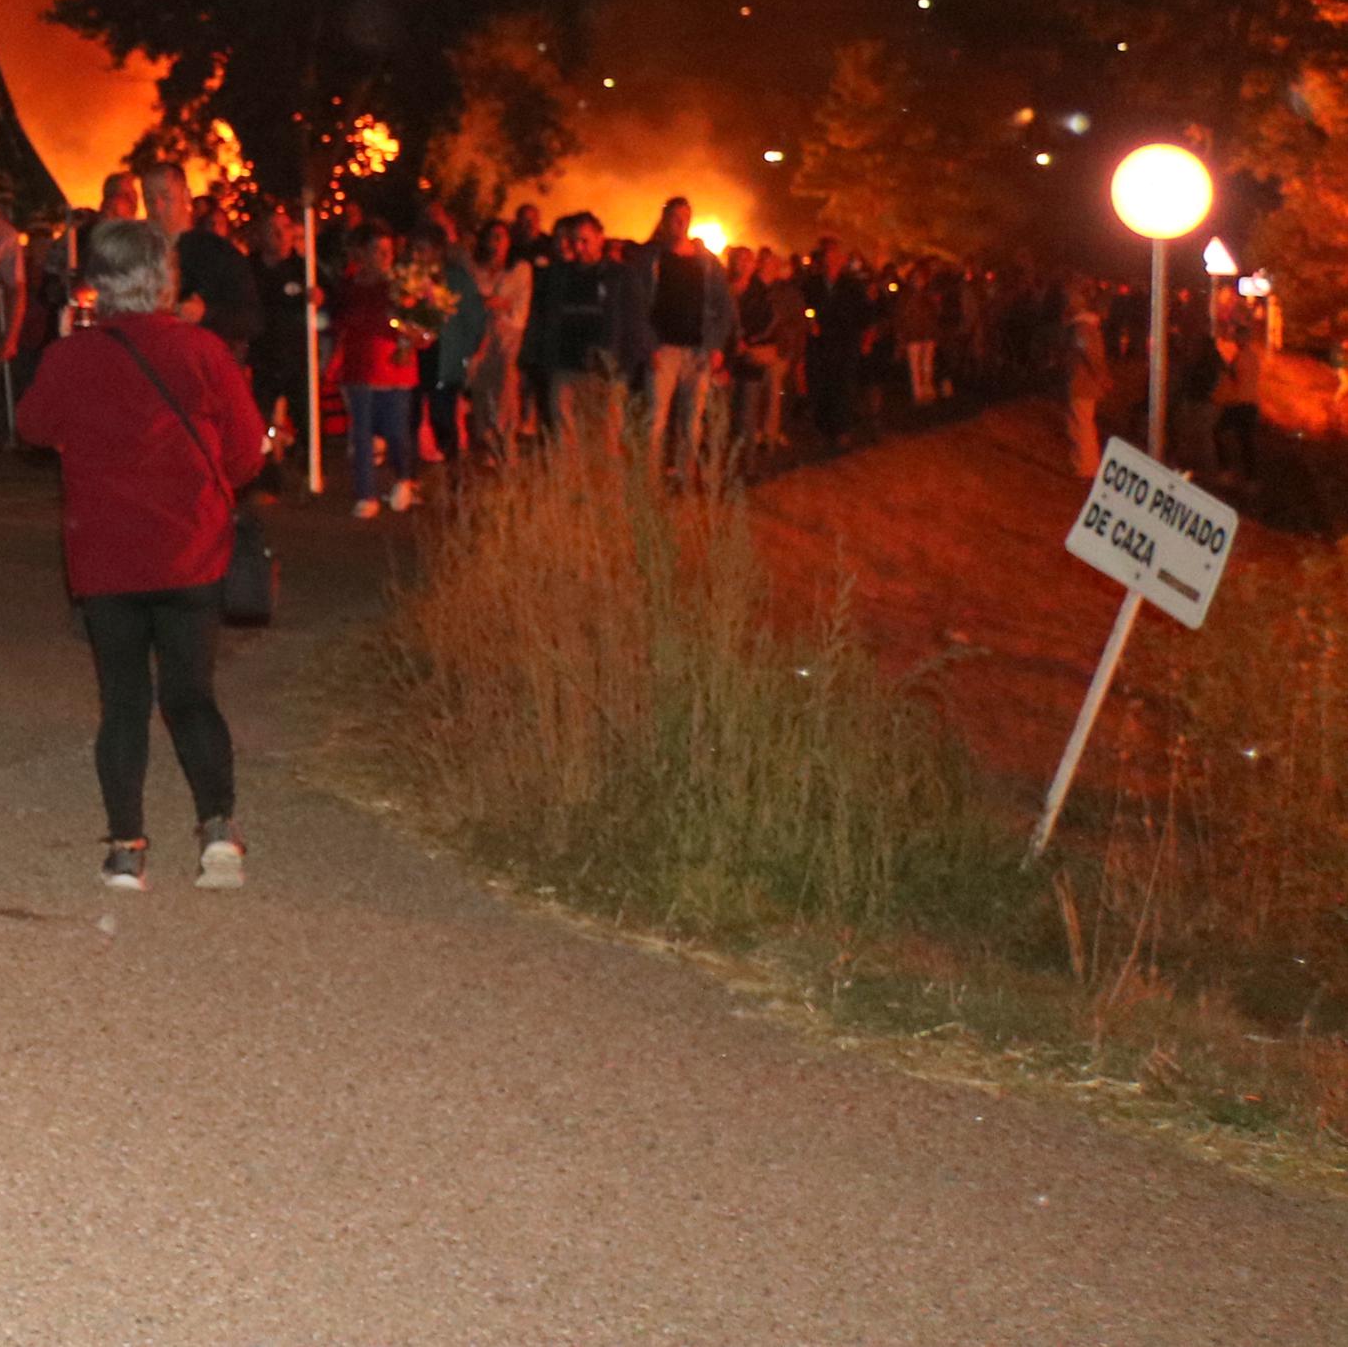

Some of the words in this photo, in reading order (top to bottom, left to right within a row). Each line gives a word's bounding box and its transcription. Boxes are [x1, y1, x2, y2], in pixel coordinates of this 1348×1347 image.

[1083, 502, 1112, 537] DE
[1110, 520, 1156, 567] CAZA
[1102, 459, 1149, 505] COTO
[1149, 489, 1226, 554] PRIVADO
